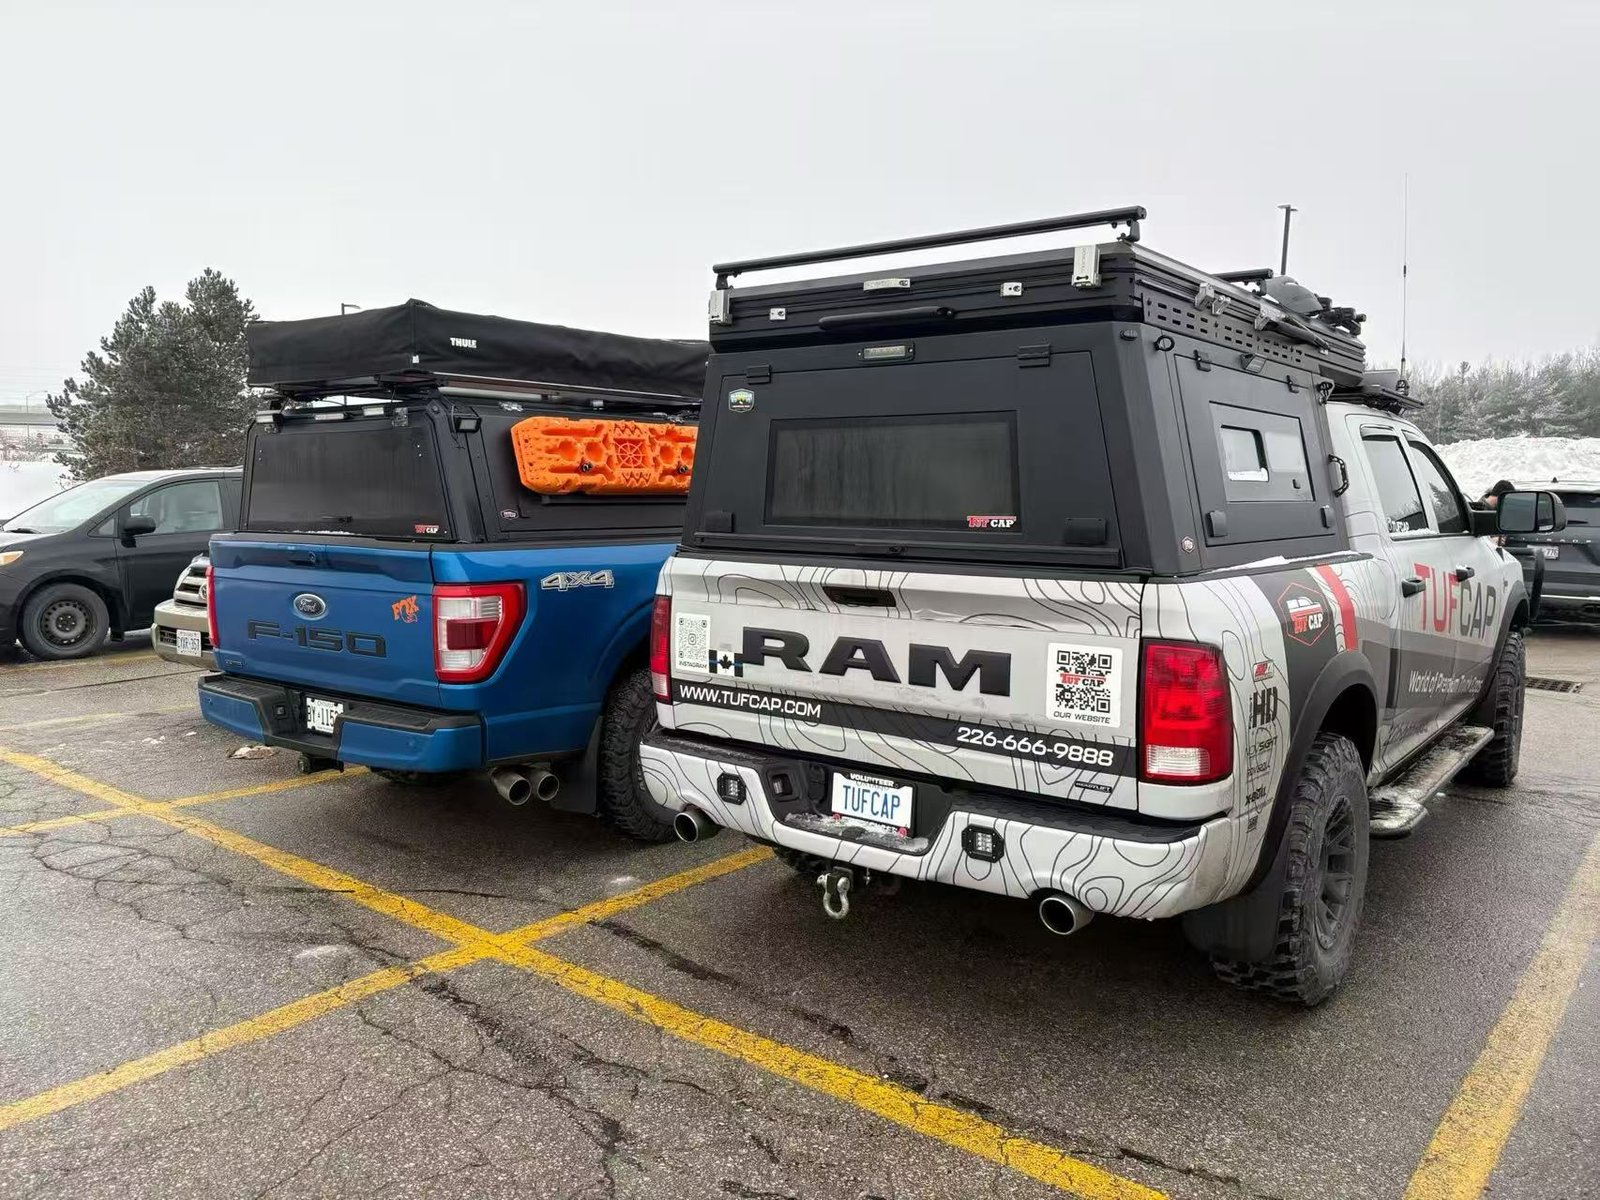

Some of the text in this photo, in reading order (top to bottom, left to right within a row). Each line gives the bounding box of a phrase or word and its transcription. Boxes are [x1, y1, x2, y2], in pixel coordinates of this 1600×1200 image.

[450, 337, 477, 349] THULE
[990, 519, 1014, 528] CAP
[299, 598, 317, 612] Ford
[1413, 562, 1497, 640] TUFCAP
[1308, 613, 1324, 630] CAP
[247, 619, 388, 658] F-150
[678, 660, 708, 669] INSTAGRAM
[742, 626, 1012, 697] RAM
[1082, 678, 1105, 687] CAP
[1408, 670, 1432, 693] World
[679, 684, 821, 718] WWW.TUFCAP.COM
[1053, 710, 1111, 724] OUR WEBSITE
[956, 726, 1115, 767] 226-666-9888
[850, 772, 895, 787] VOLUNTEER
[843, 784, 901, 820] TUFCAP
